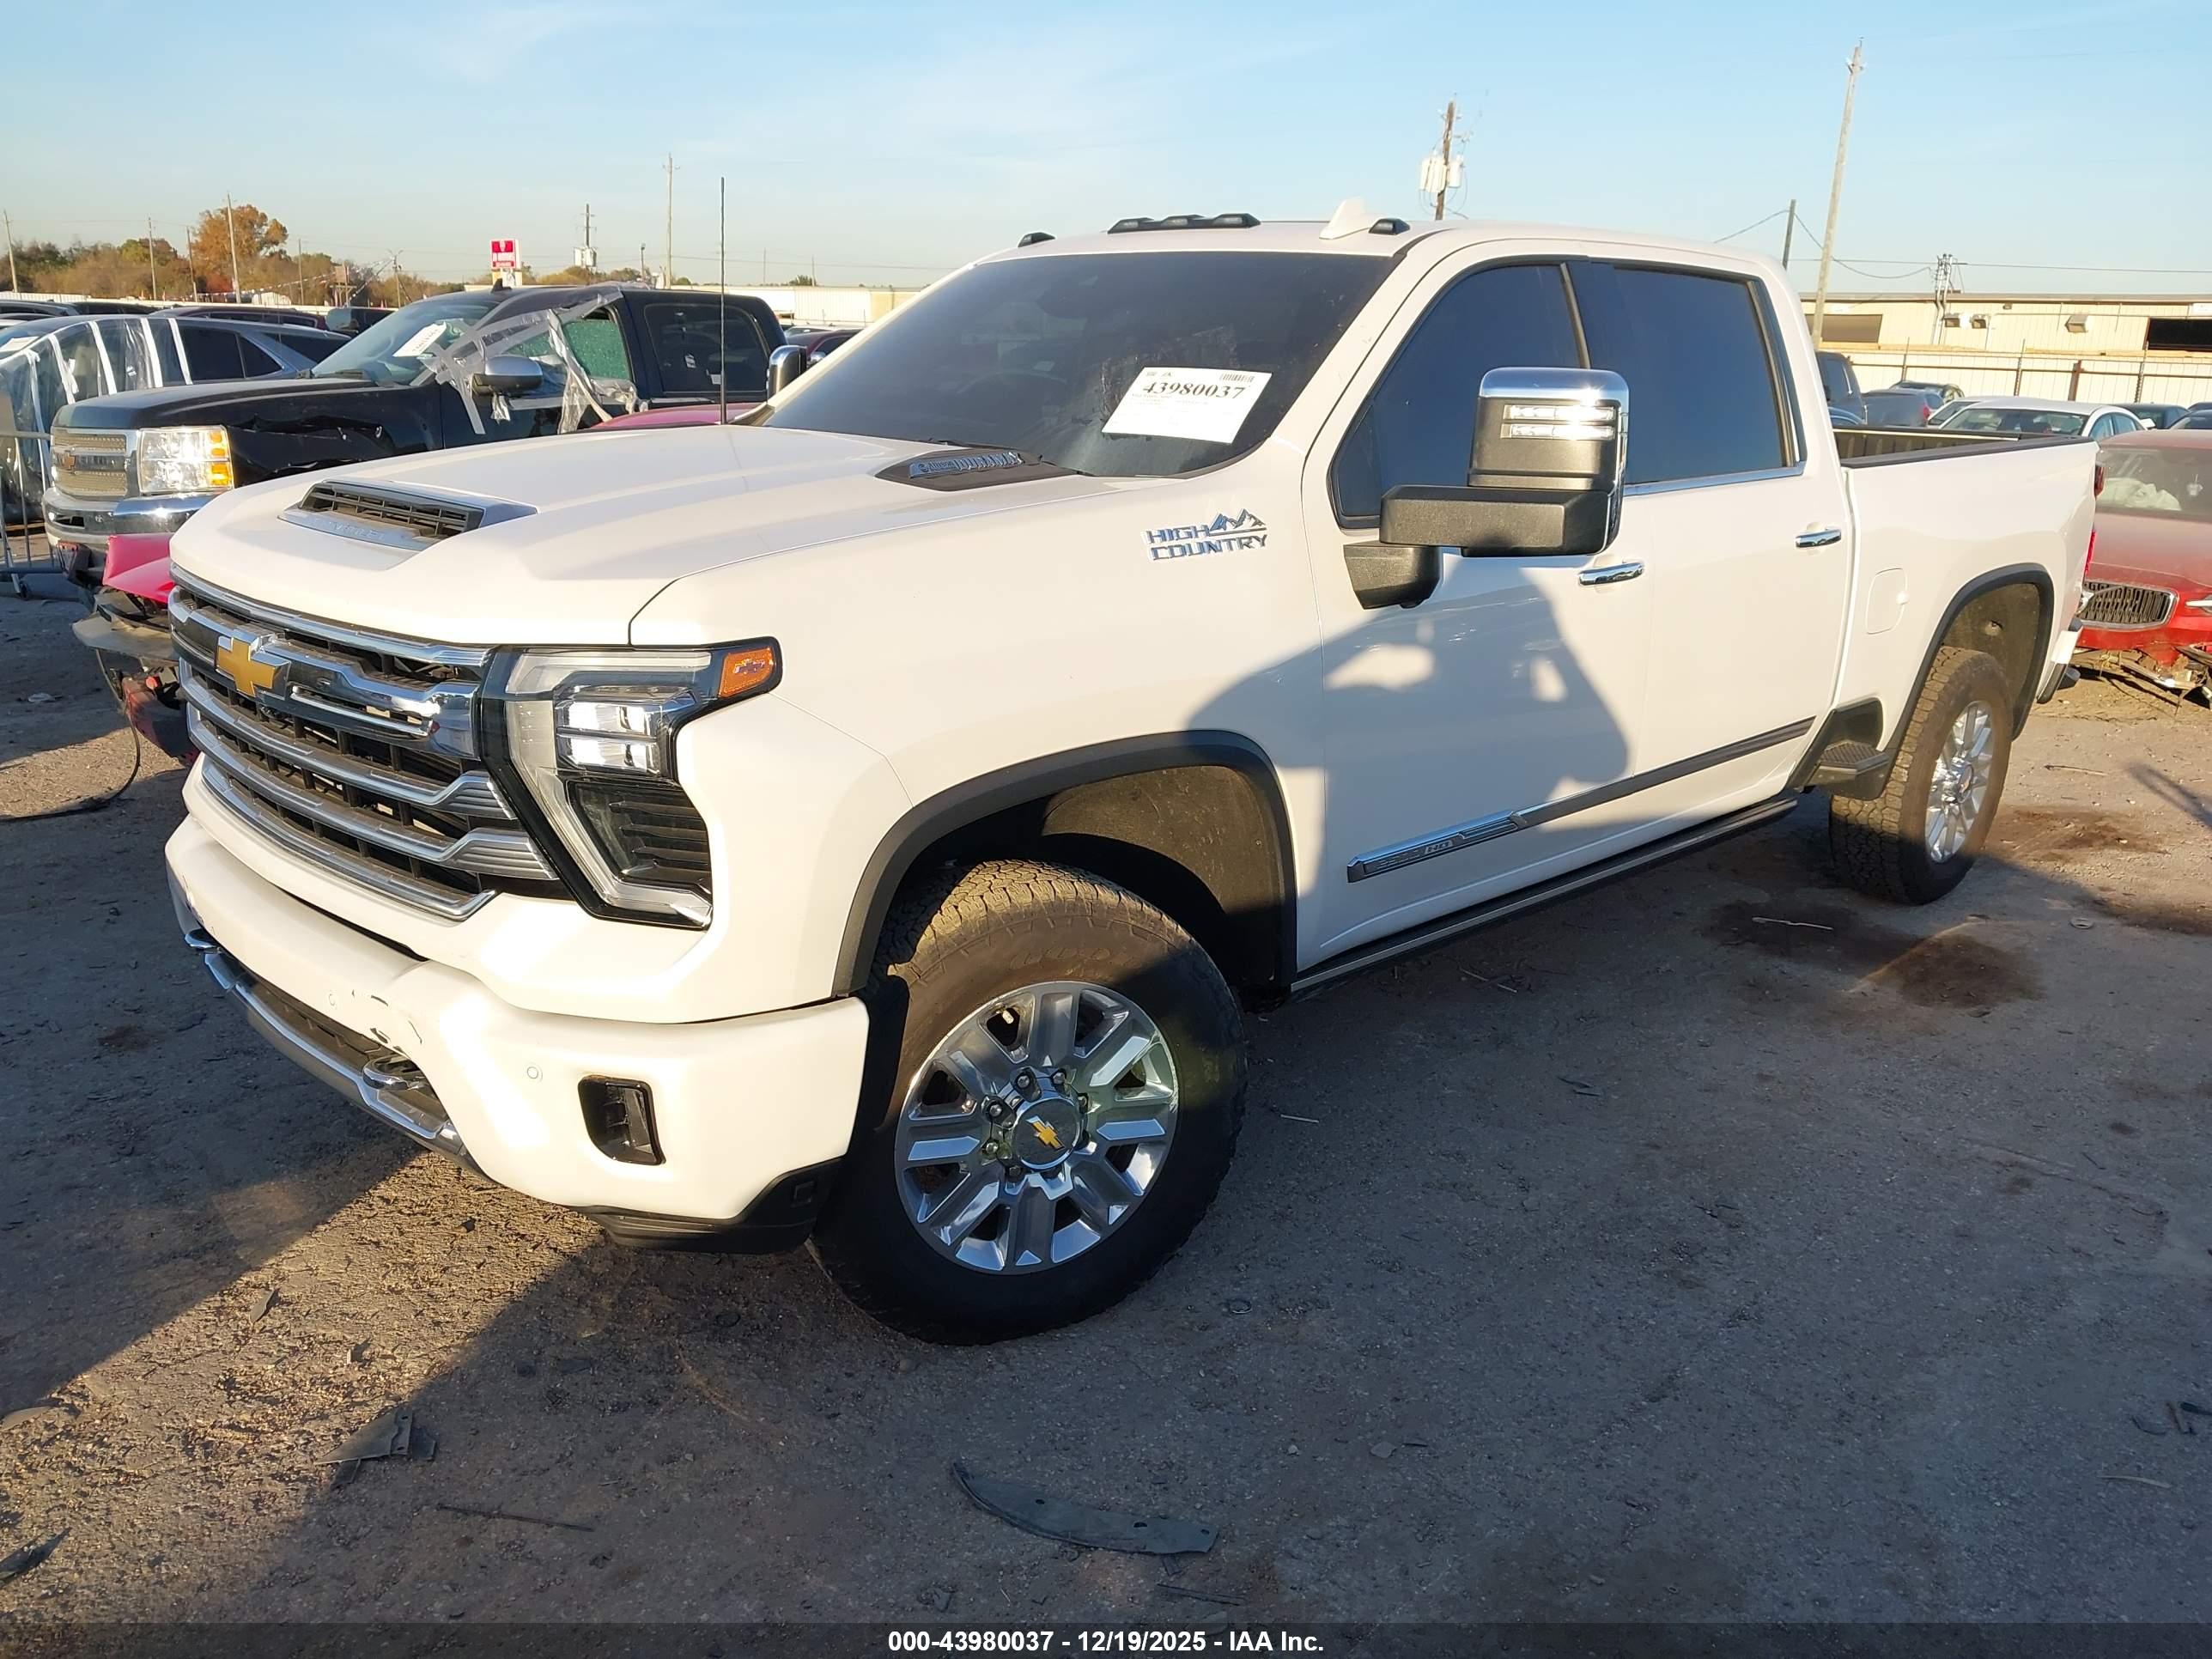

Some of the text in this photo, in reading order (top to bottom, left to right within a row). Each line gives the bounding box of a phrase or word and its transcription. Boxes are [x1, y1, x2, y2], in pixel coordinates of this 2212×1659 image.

[1143, 381, 1246, 399] 43980037
[1145, 524, 1211, 544] HIGH
[1150, 533, 1268, 561] COUNTRY
